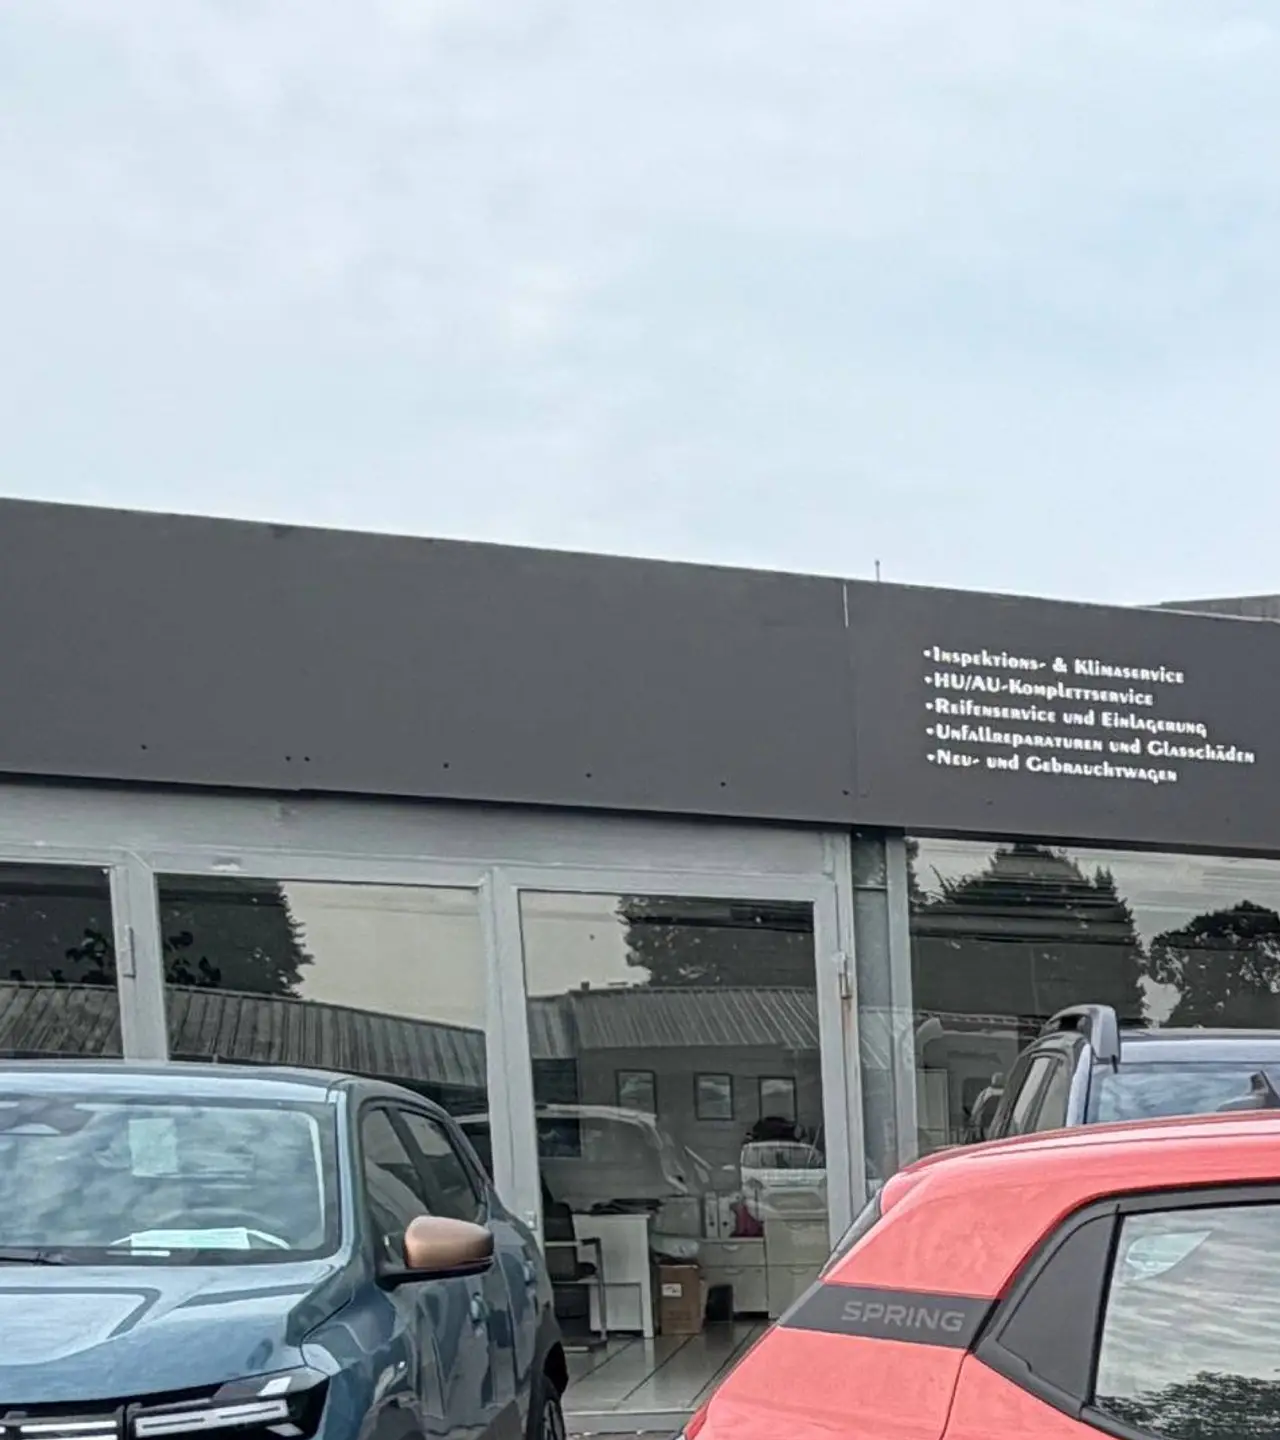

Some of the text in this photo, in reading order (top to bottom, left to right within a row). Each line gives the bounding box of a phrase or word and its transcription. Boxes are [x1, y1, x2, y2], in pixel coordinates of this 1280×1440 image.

[1052, 657, 1067, 673] &
[1074, 658, 1185, 684] Klimaservice
[935, 698, 1208, 739] Reifenservice und Einlagerung
[936, 723, 1255, 764] Unfallreparaturen und Glasschäden
[936, 749, 1178, 784] Neu- und Gebrauchtwagen
[841, 1301, 966, 1332] SPRING
